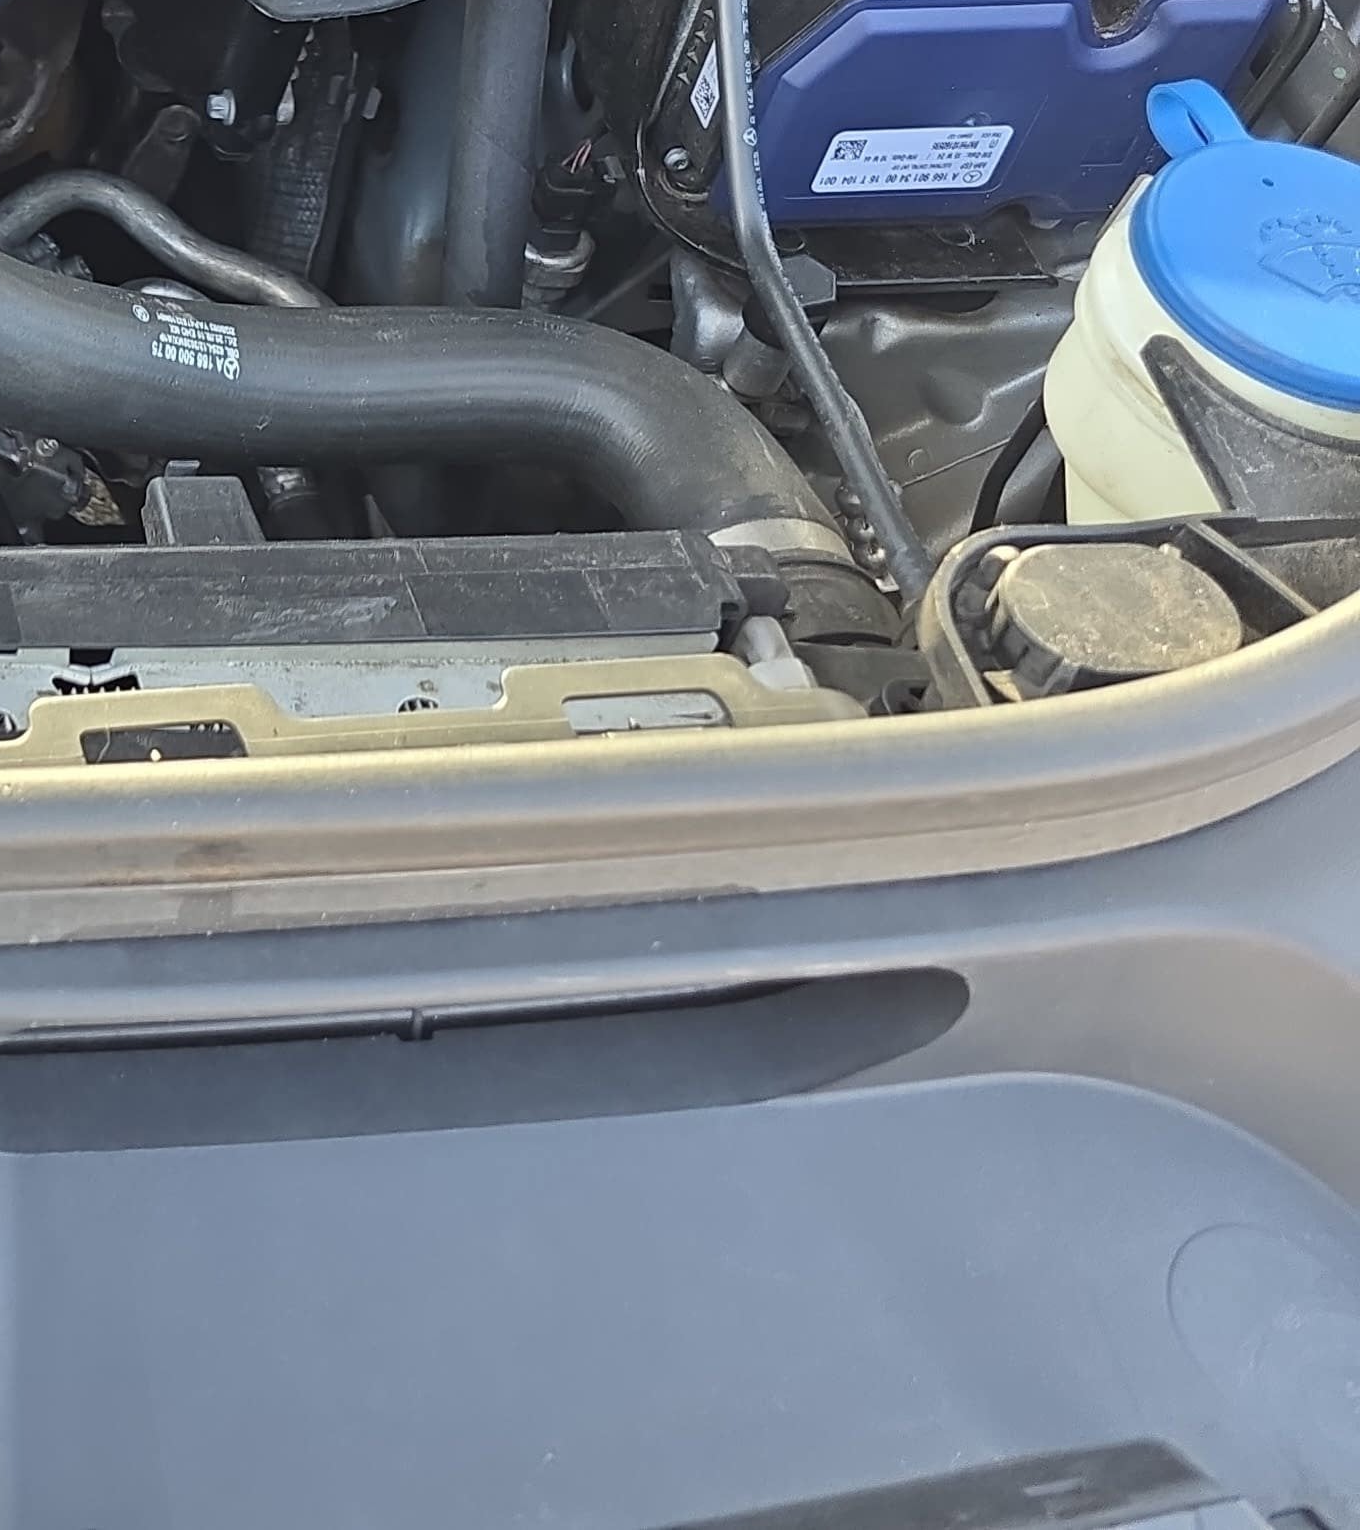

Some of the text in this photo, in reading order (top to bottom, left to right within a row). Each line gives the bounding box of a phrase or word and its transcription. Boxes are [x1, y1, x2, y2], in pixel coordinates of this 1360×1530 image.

[841, 176, 858, 185] 104
[884, 174, 897, 184] 00
[899, 174, 912, 183] 34
[913, 173, 930, 183] 901
[932, 172, 948, 182] 166
[151, 340, 164, 358] 75
[164, 344, 177, 362] 00
[178, 348, 196, 366] 500
[215, 356, 225, 374] A
